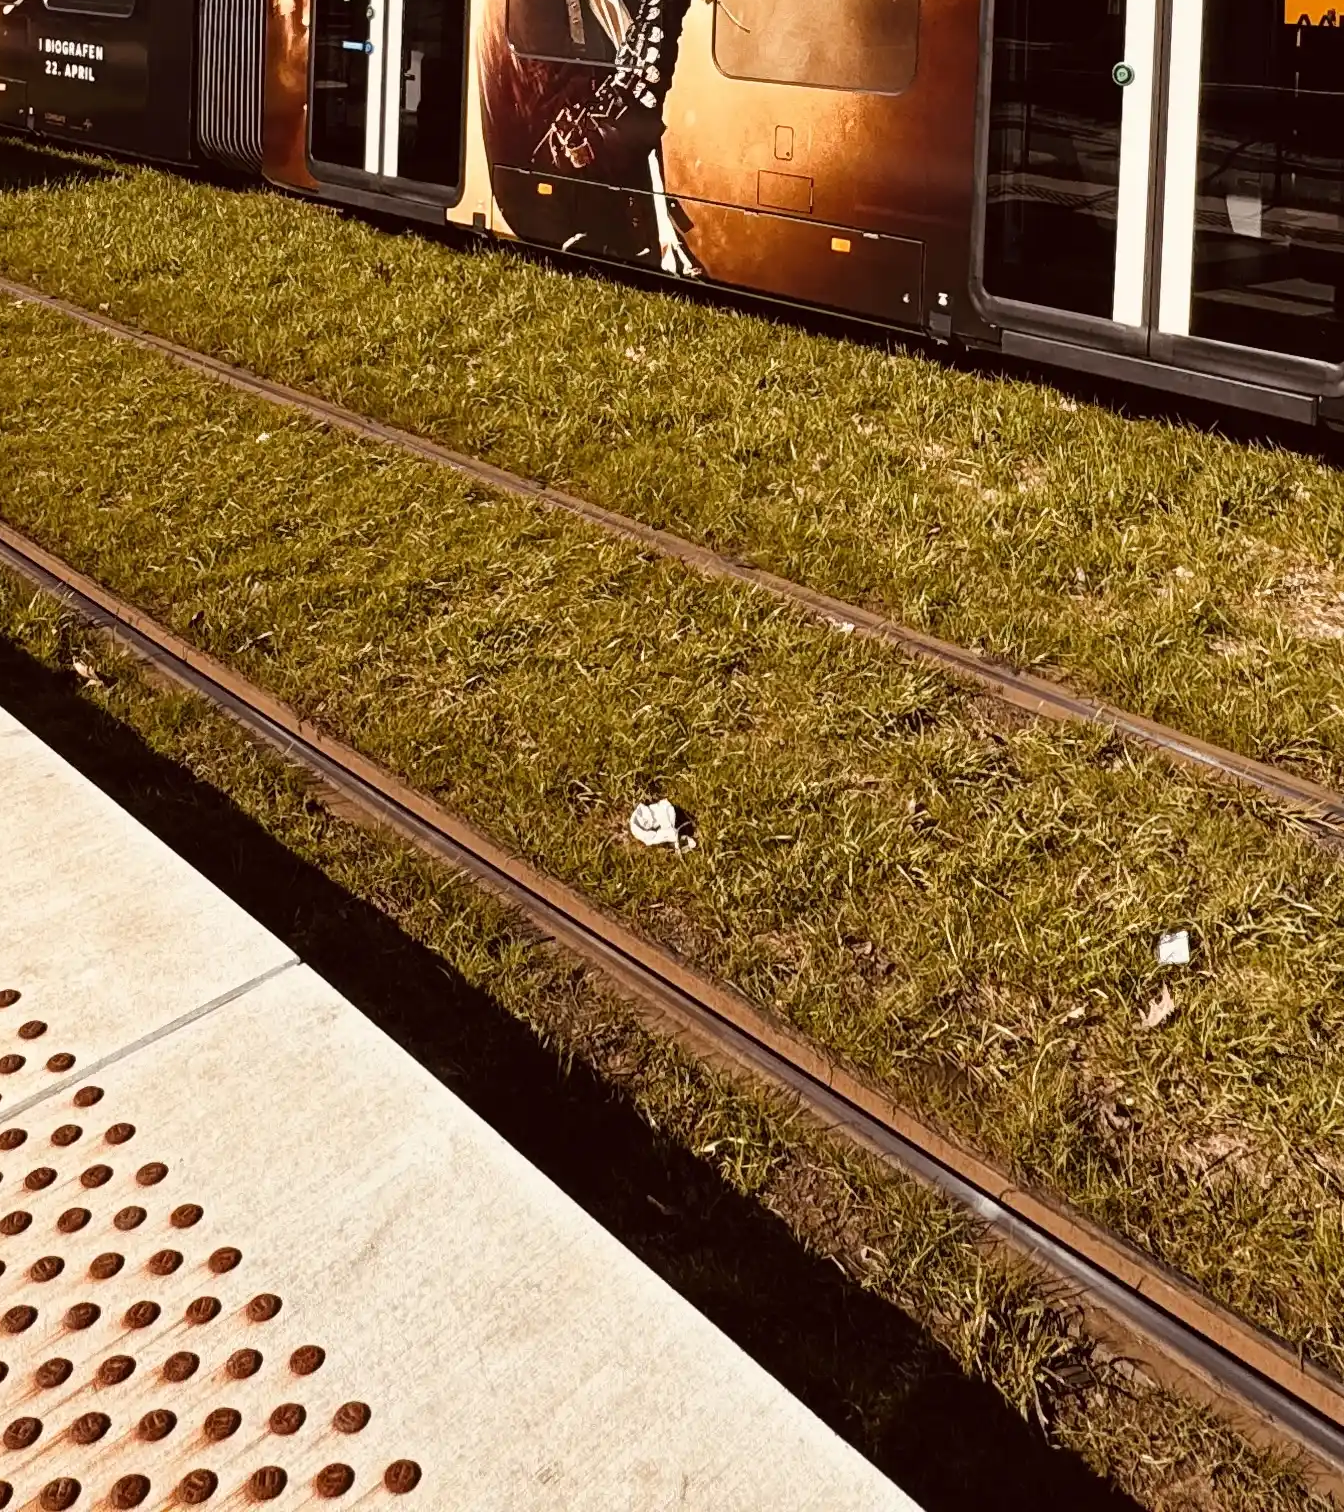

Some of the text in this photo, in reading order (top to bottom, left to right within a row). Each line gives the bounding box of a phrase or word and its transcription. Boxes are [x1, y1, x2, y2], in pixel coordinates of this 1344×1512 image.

[38, 37, 104, 61] I BIOGRAFEN
[44, 60, 96, 82] 22. APRIL
